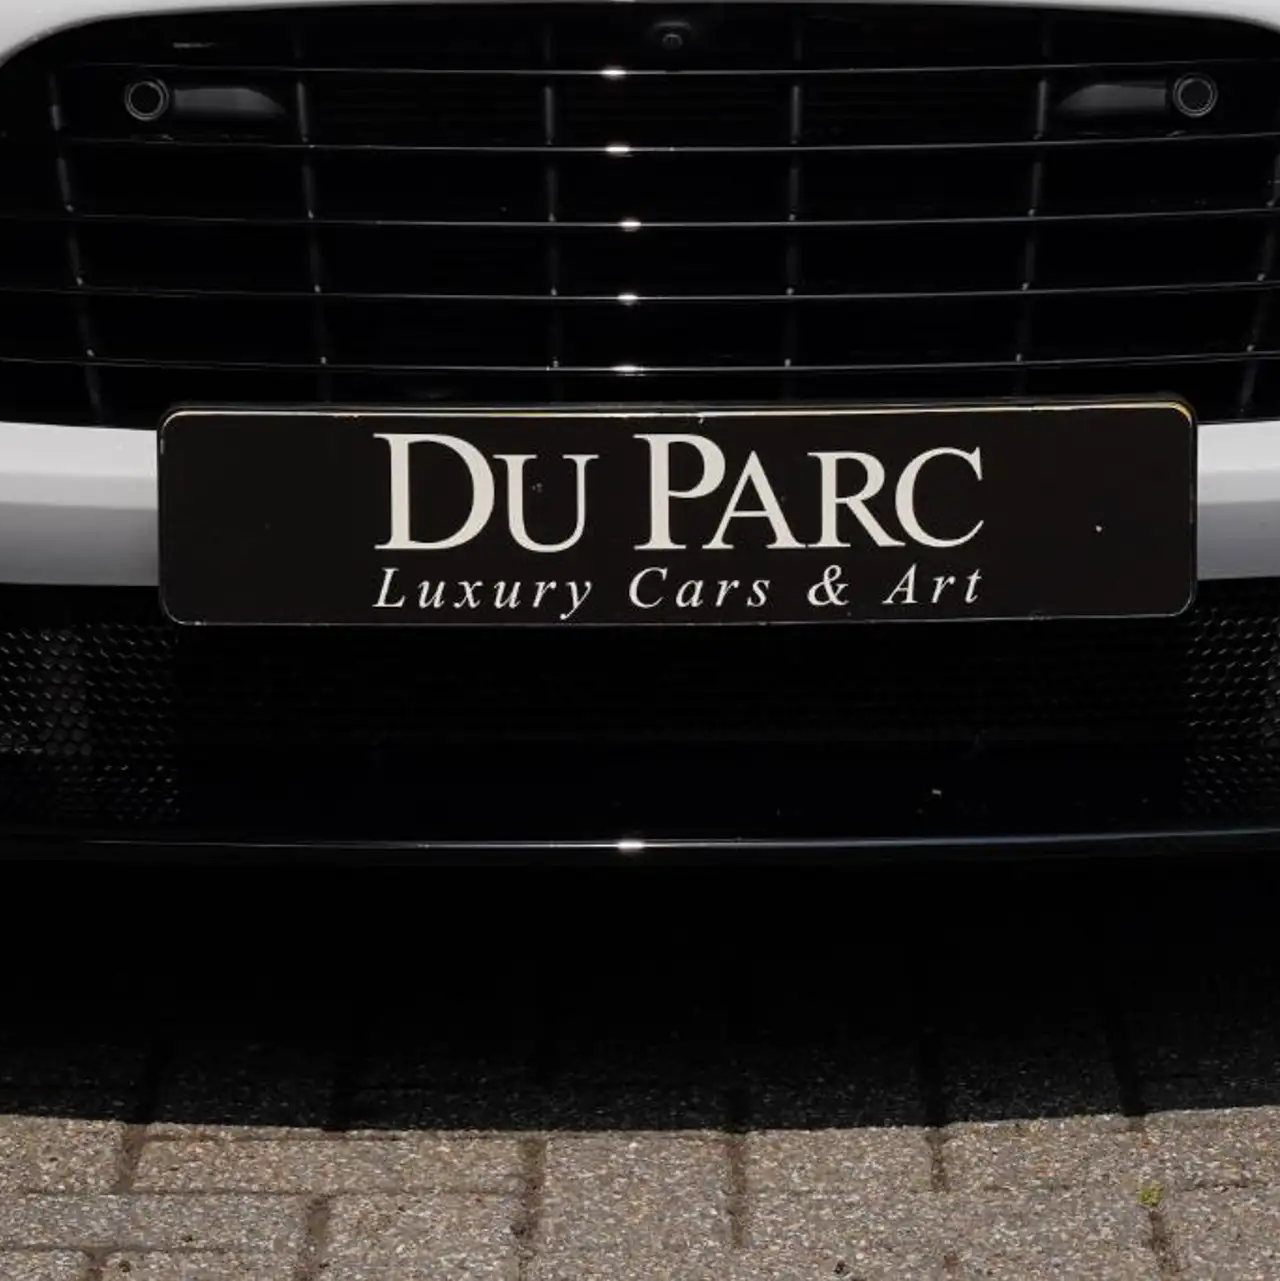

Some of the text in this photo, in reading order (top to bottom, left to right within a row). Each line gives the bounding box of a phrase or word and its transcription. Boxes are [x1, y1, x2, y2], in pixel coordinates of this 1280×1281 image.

[373, 432, 984, 553] DU PARC
[372, 564, 982, 621] Luxury Cars & Art
